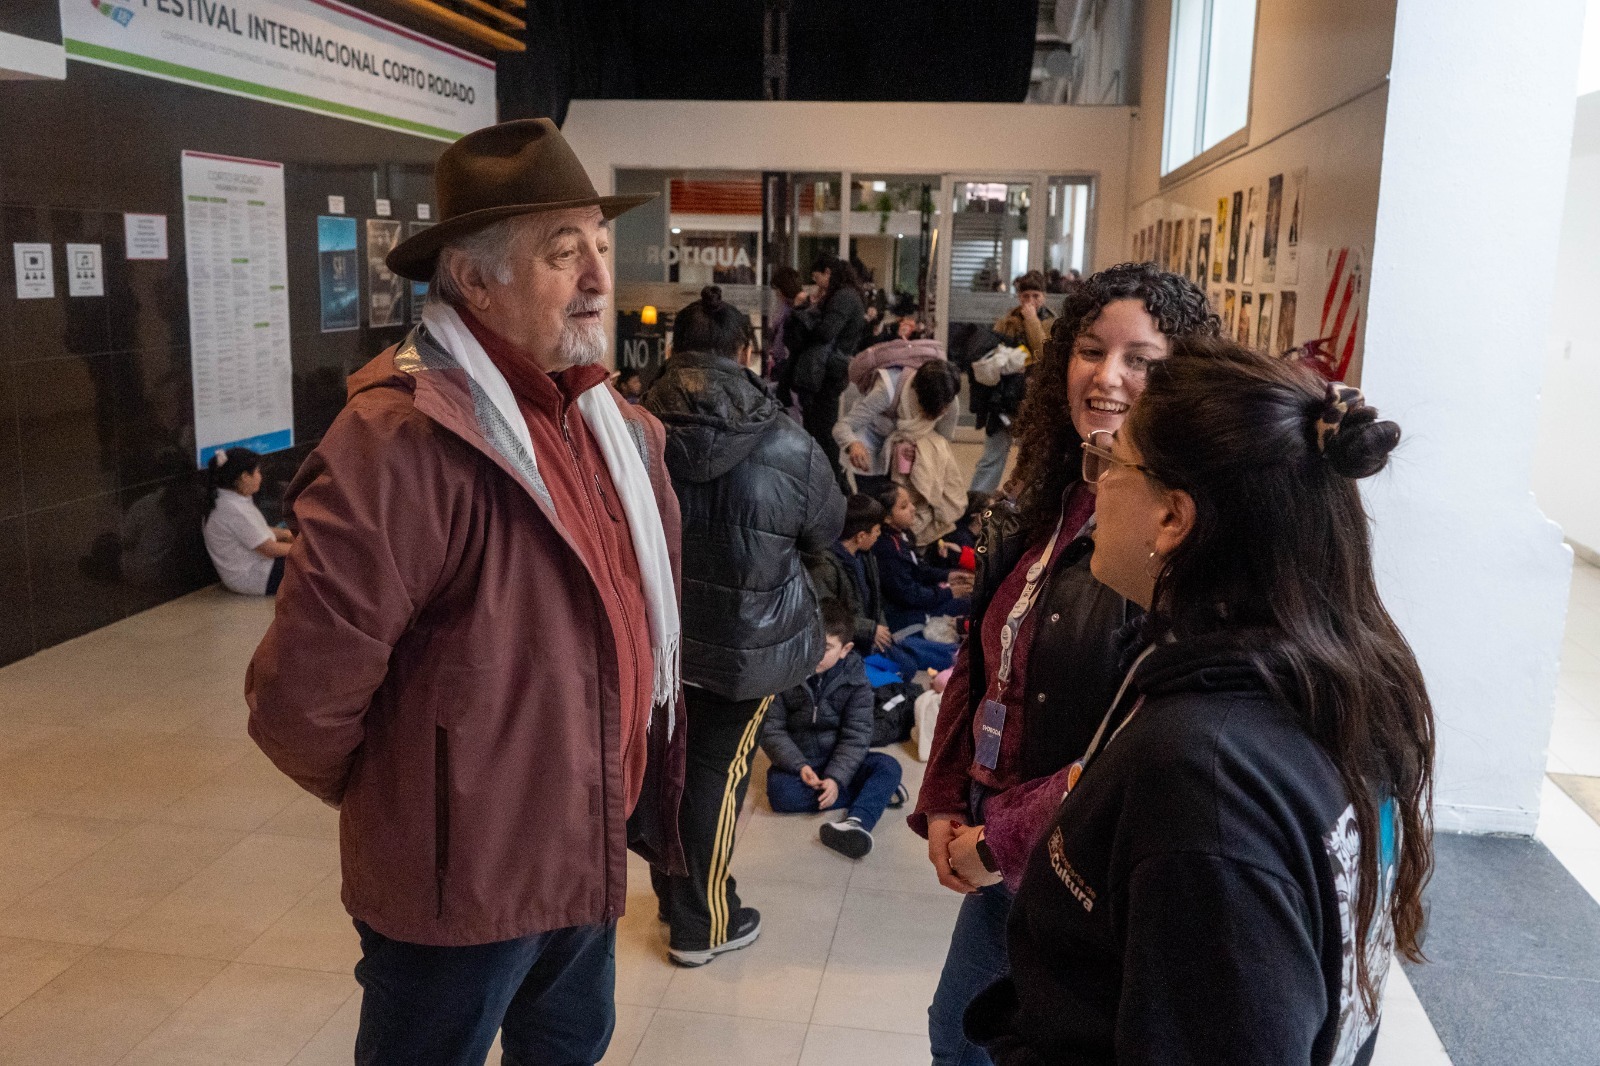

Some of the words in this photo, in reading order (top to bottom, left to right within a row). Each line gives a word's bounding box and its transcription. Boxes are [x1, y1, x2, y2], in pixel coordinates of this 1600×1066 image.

[143, 0, 242, 35] ESTIVAL
[249, 13, 380, 77] INTERNACIONAL
[382, 58, 425, 90] CORTO
[427, 74, 476, 105] RODADO
[624, 338, 650, 368] NO
[1051, 852, 1094, 912] Cultura
